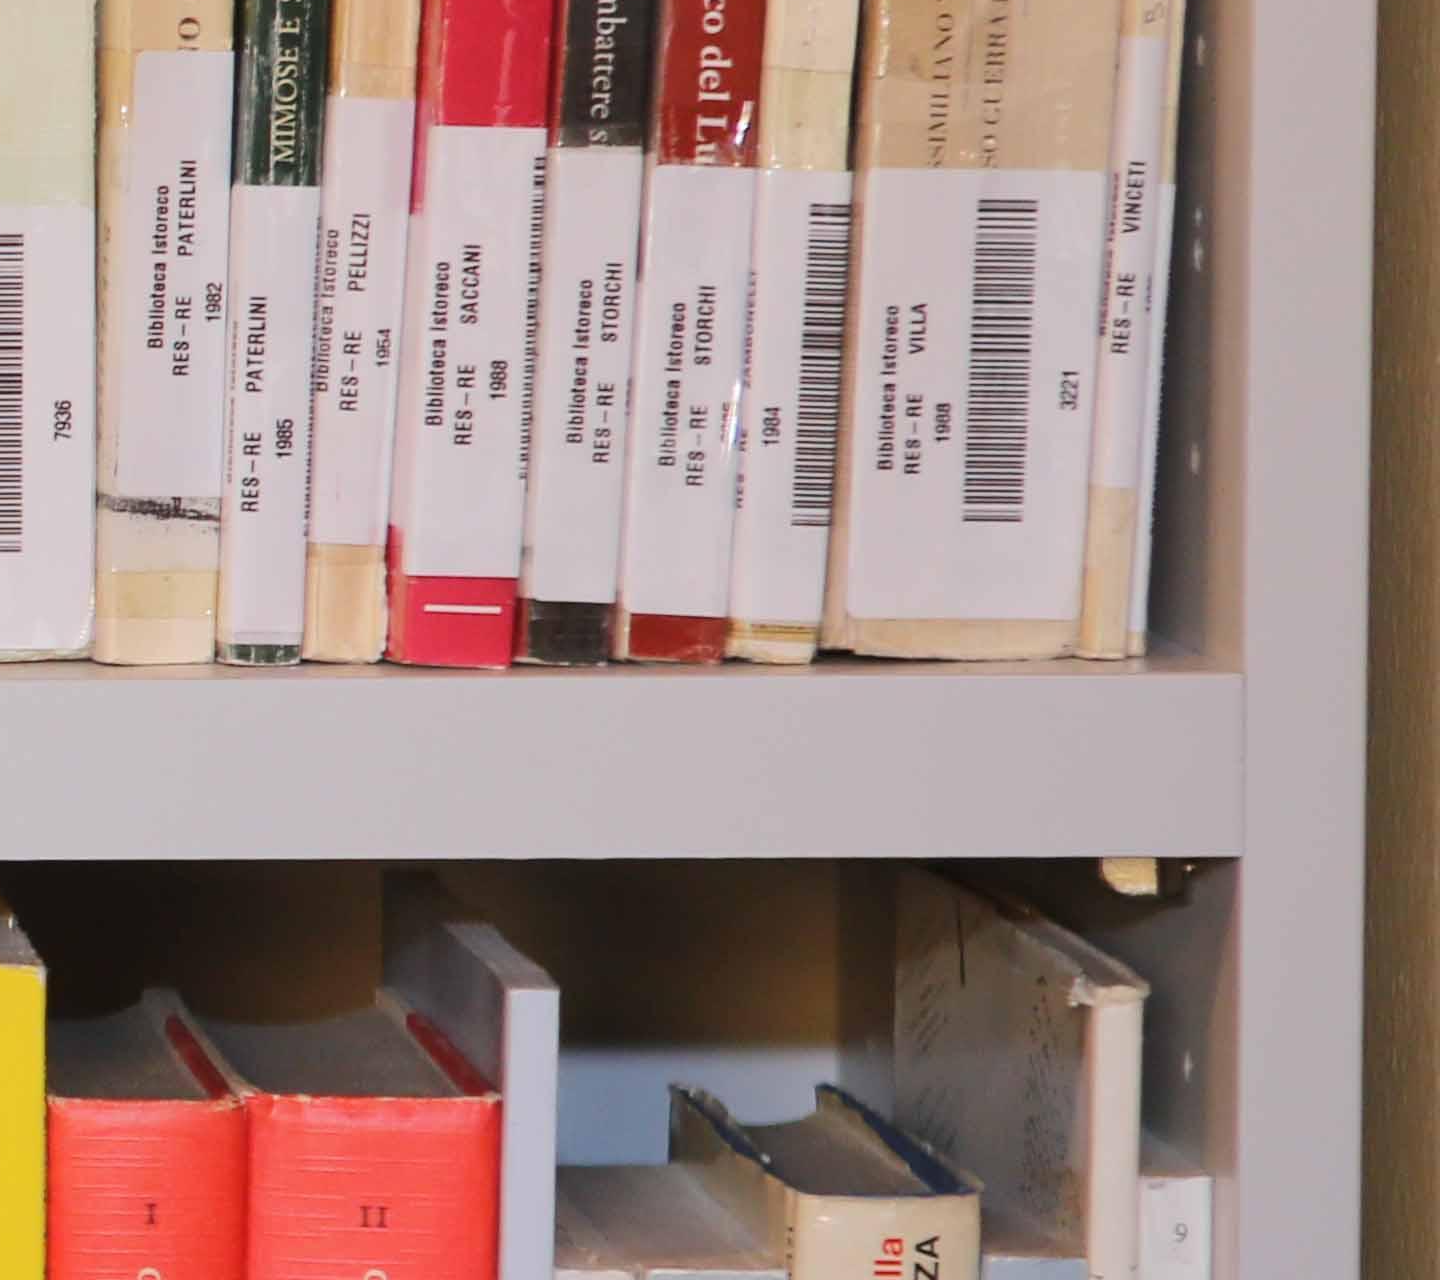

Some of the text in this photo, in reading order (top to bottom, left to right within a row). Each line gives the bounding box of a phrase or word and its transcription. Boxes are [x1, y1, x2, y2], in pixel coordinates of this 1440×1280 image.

[695, 45, 738, 102] del
[1059, 369, 1079, 411] 3221
[53, 400, 72, 441] 7936
